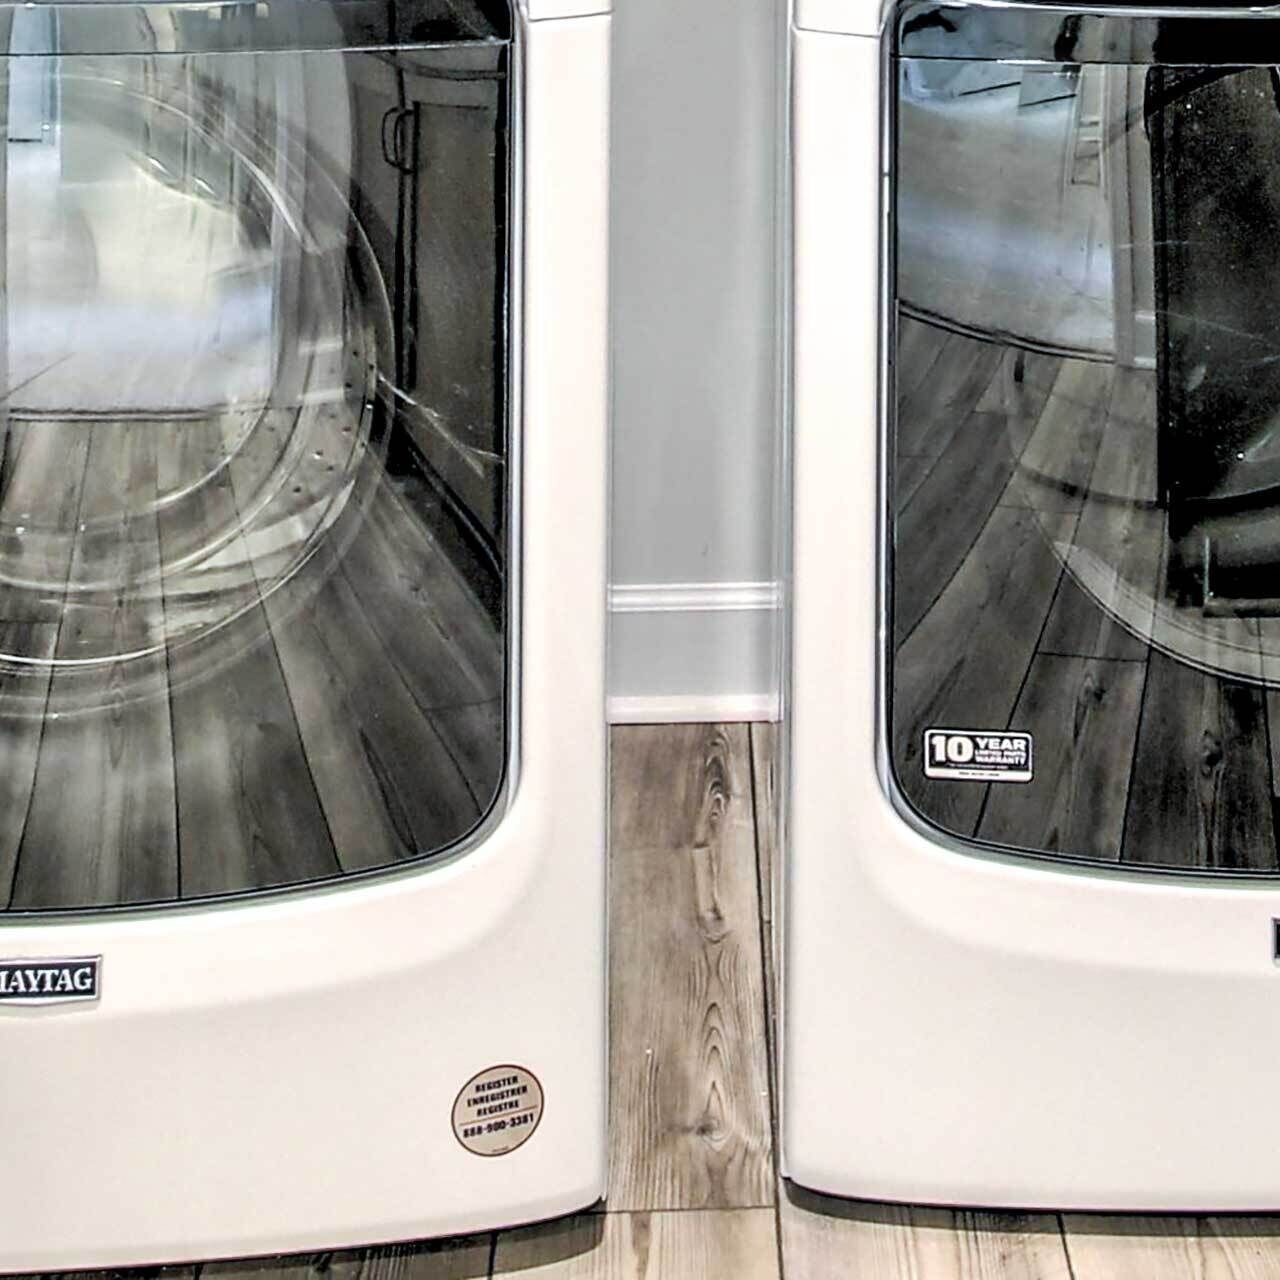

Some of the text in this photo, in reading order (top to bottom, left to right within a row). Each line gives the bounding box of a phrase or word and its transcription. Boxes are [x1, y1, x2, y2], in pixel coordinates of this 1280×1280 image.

[932, 735, 1026, 762] 10 YEAR
[475, 1075, 519, 1093] REGISTER
